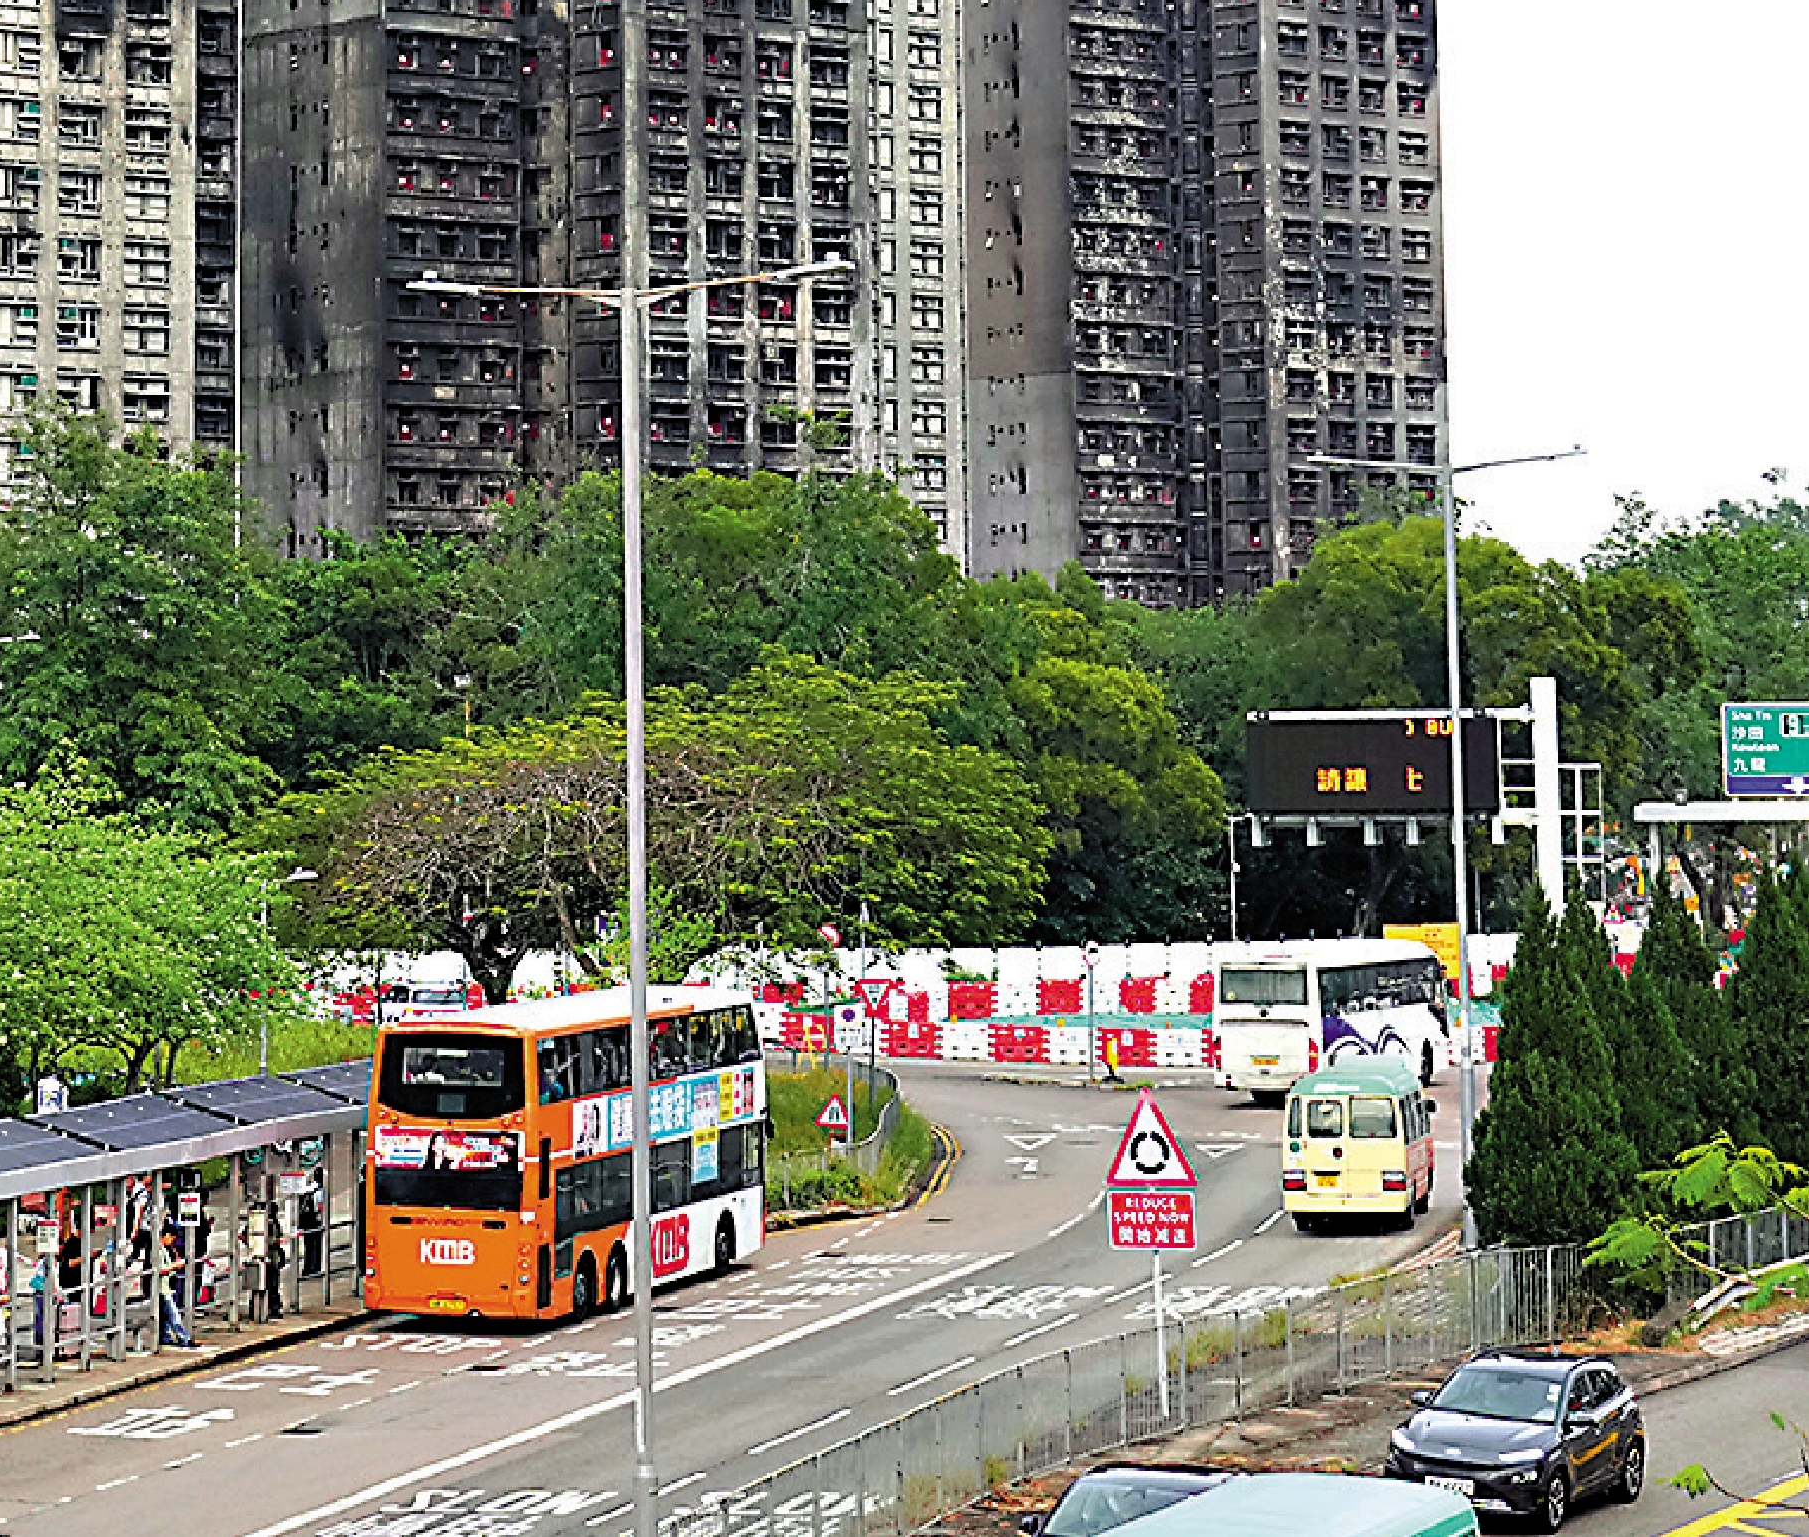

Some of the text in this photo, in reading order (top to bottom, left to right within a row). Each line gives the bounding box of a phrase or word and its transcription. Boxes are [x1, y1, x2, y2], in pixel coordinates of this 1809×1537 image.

[1125, 1197, 1177, 1211] REDUCE
[1113, 1211, 1191, 1225] SPEED NOW
[420, 1237, 476, 1265] KMB
[320, 1334, 503, 1354] STOP
[380, 1489, 620, 1515] SLOW
